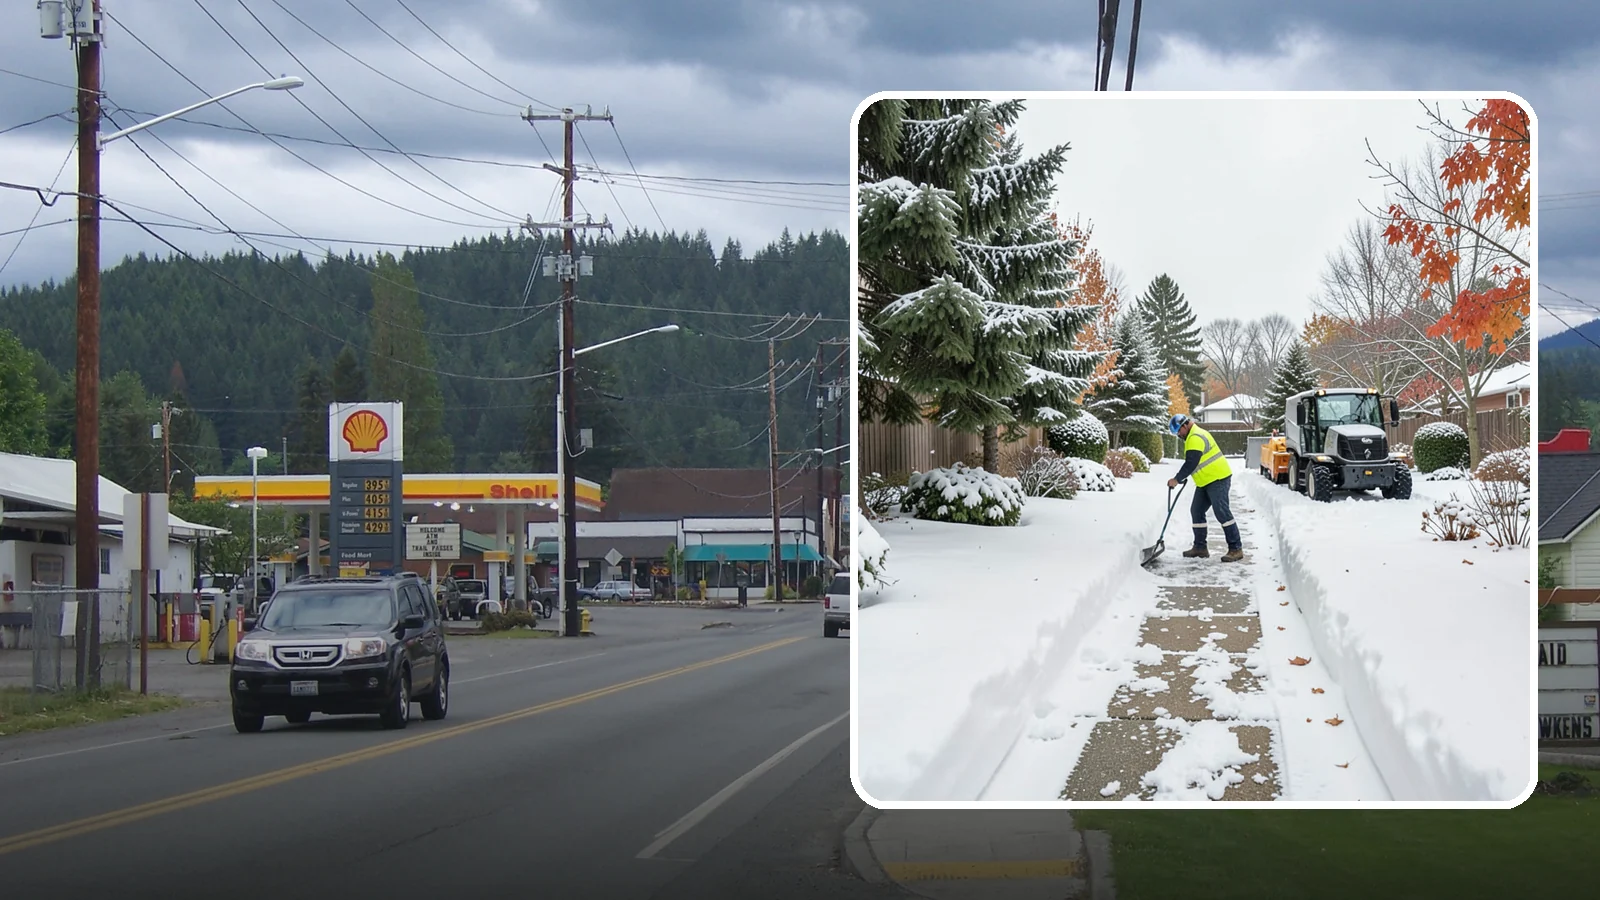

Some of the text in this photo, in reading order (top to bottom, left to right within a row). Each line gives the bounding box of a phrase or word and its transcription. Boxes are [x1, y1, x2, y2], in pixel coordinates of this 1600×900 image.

[366, 480, 383, 490] 395
[490, 484, 547, 499] Shell
[366, 494, 383, 504] 405
[366, 508, 383, 518] 415
[366, 522, 383, 532] 429
